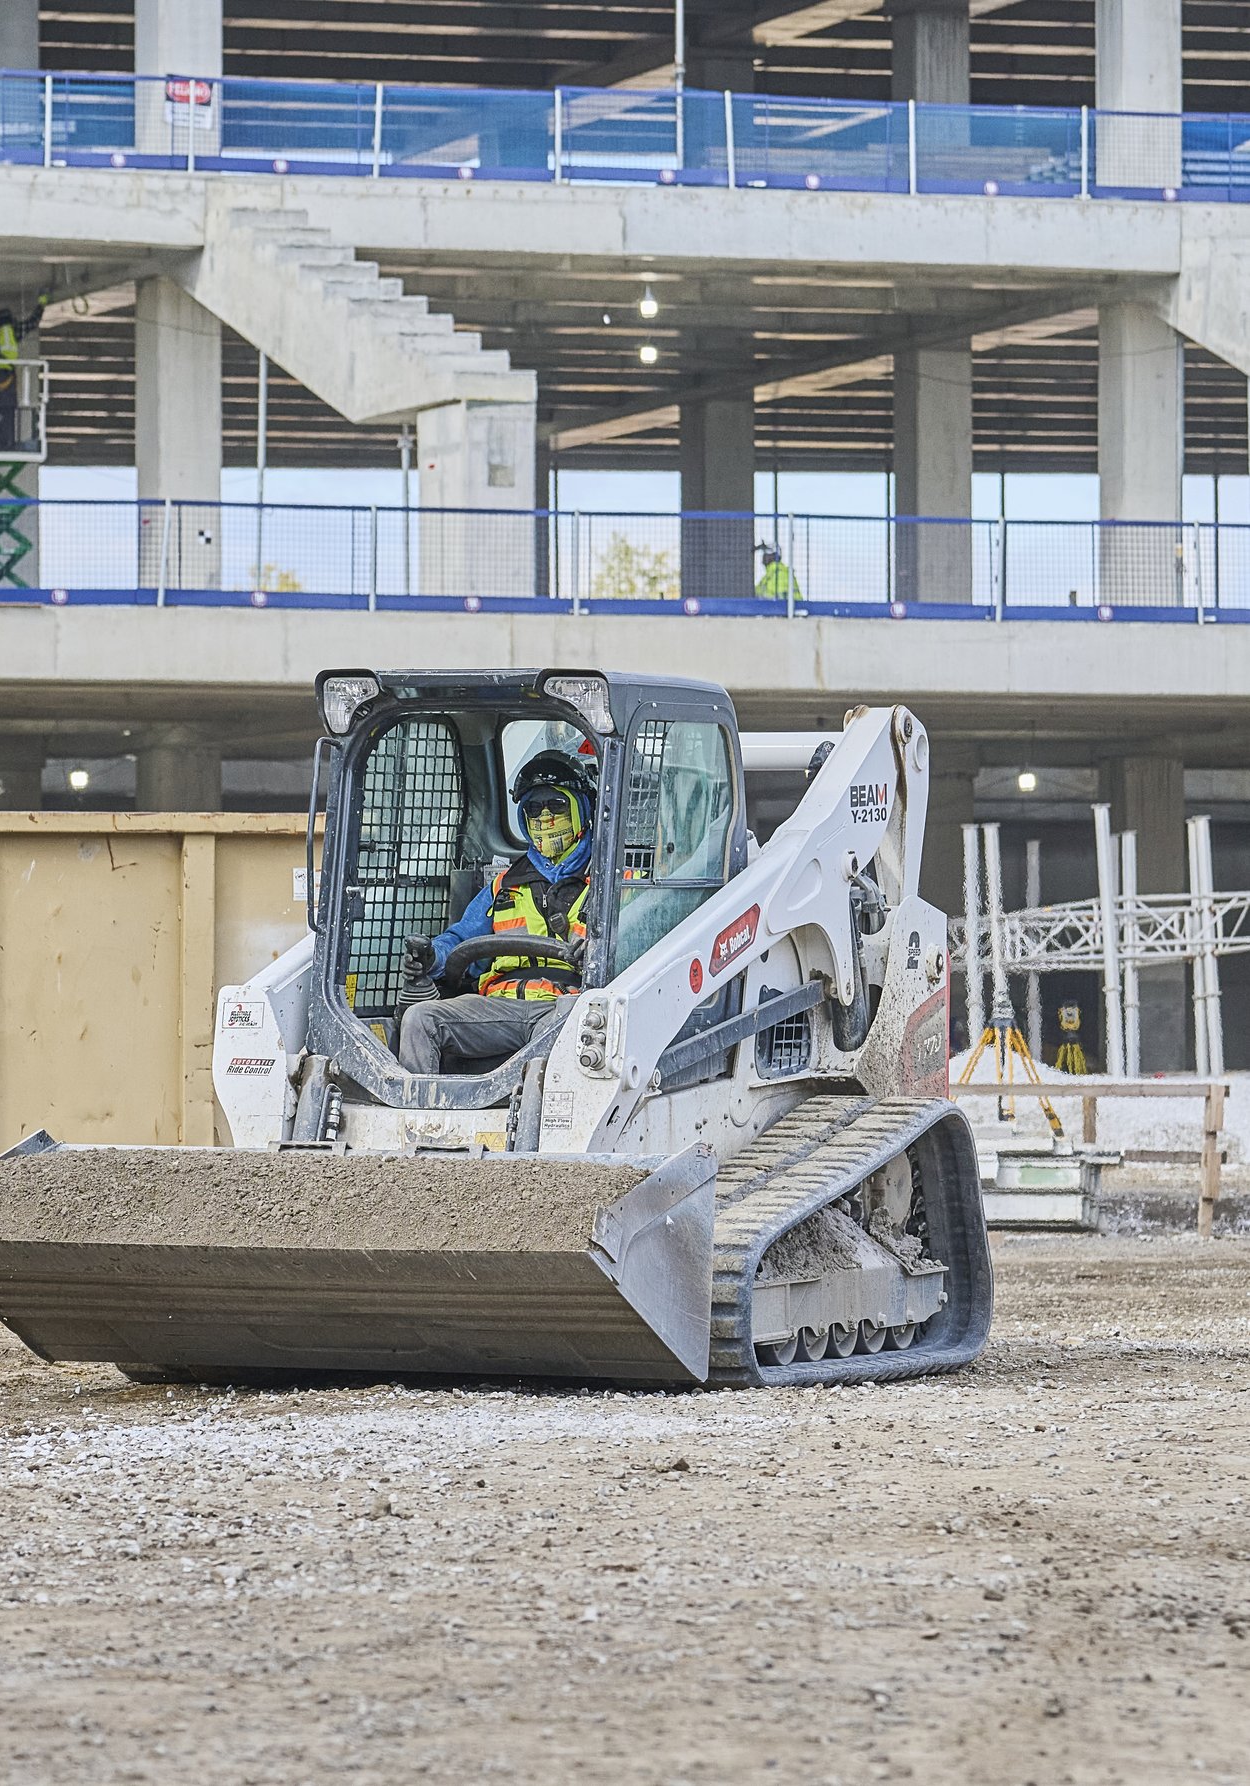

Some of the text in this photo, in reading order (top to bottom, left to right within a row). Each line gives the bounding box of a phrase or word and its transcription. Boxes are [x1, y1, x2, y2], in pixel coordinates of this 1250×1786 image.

[850, 783, 887, 808] BEAM
[851, 807, 887, 824] Y-2130
[729, 924, 751, 955] Bobcat
[226, 1065, 272, 1075] Ride Control
[231, 1058, 274, 1066] AUTOMATIC
